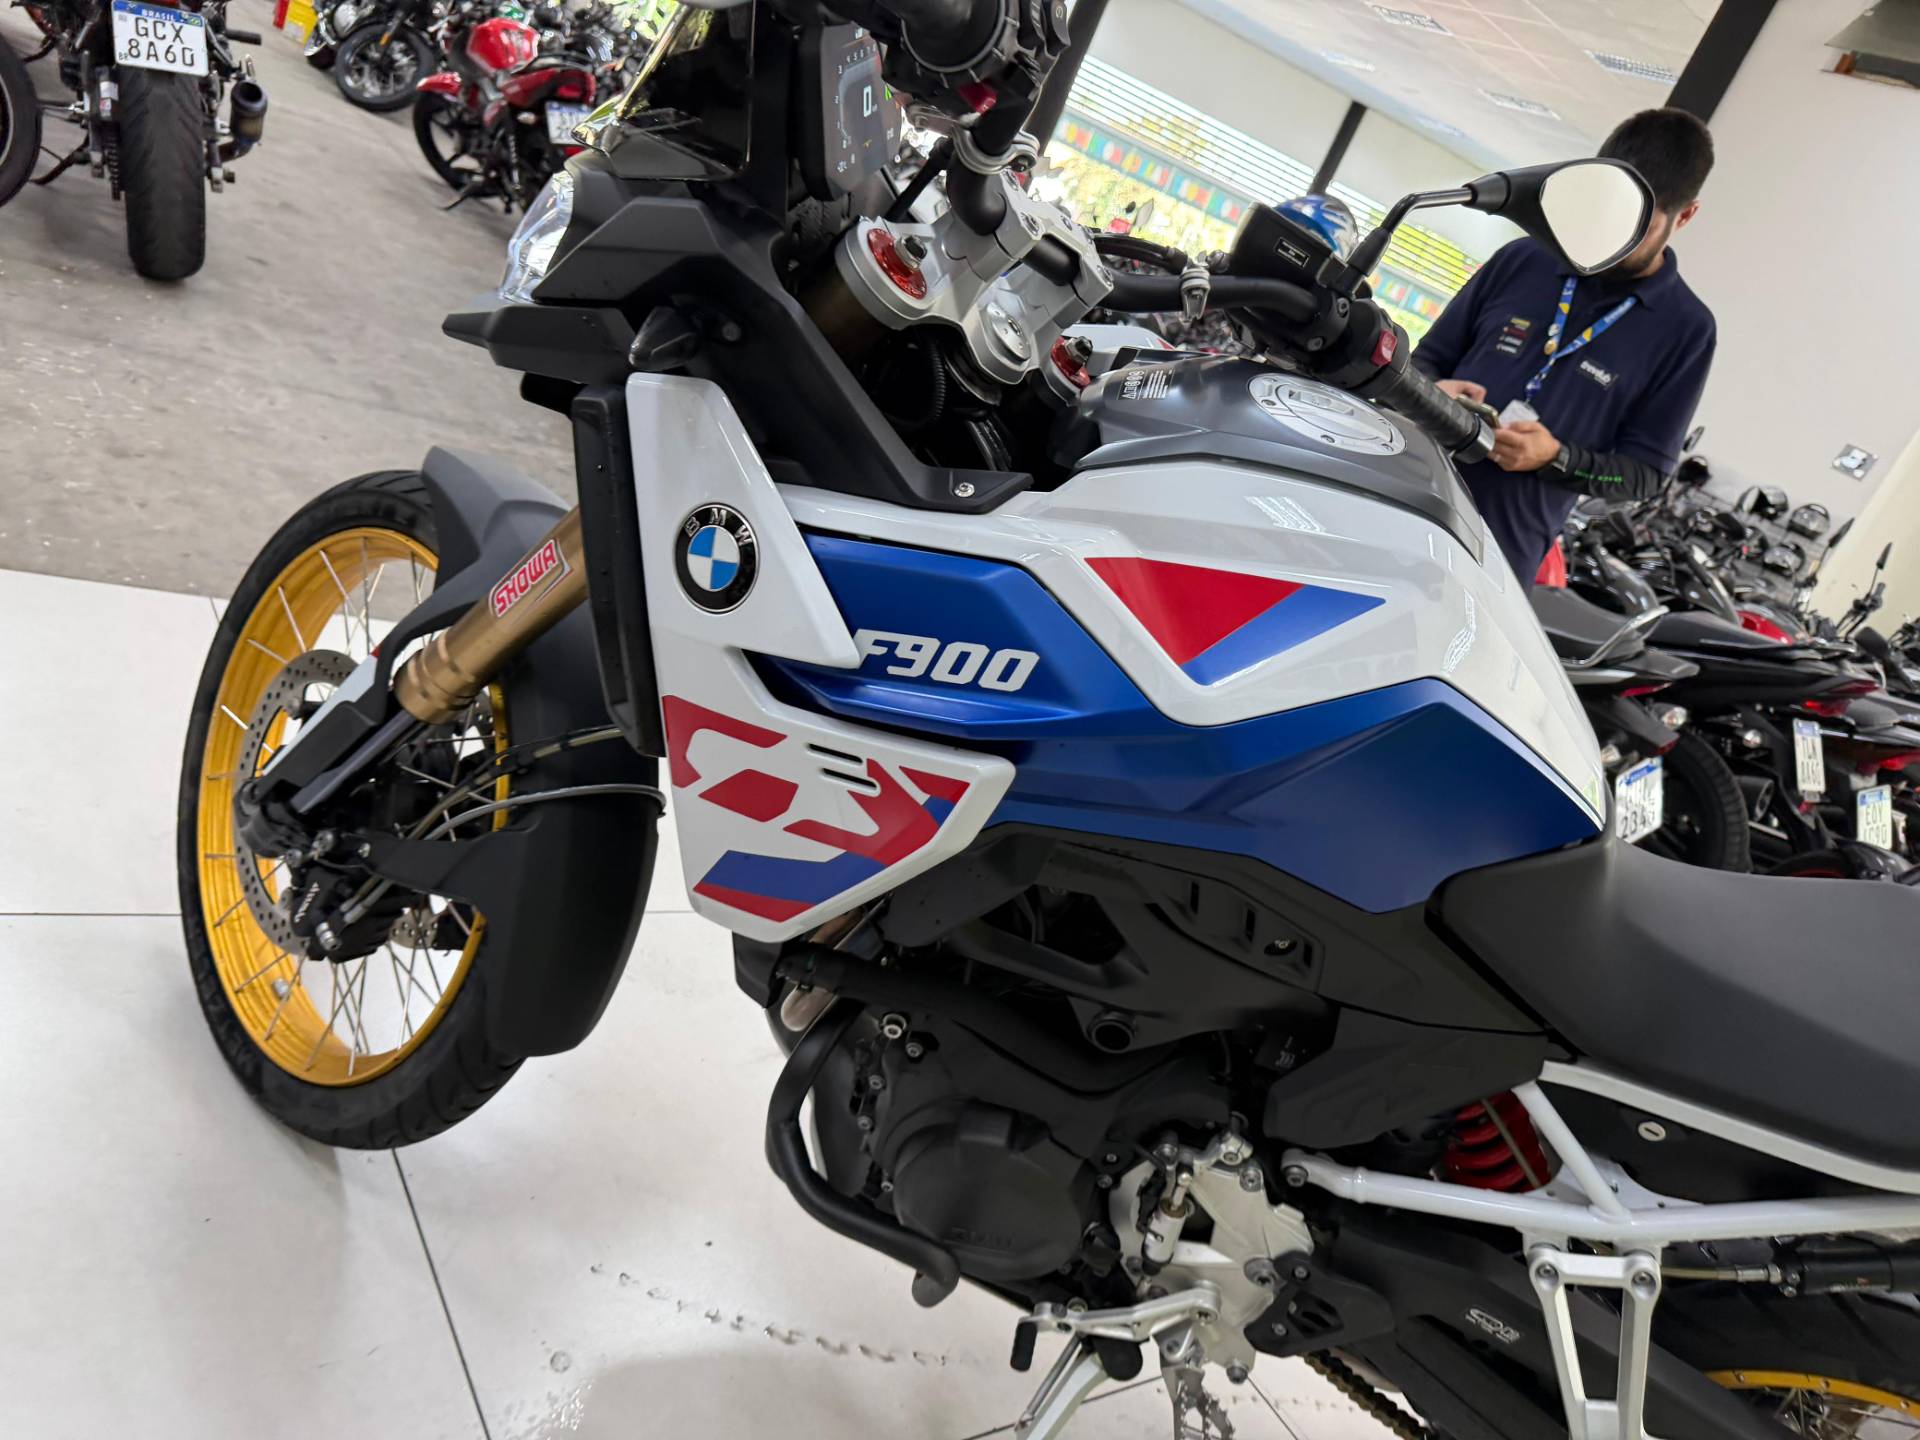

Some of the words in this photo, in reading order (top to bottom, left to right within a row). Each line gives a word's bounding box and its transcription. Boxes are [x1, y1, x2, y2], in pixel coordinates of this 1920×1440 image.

[135, 17, 184, 44] GCX
[141, 9, 175, 21] BRASIL
[128, 38, 195, 67] 8A60
[863, 85, 872, 117] 0
[685, 508, 752, 547] BMW
[494, 540, 559, 618] SHOWA
[852, 628, 1040, 692] F900
